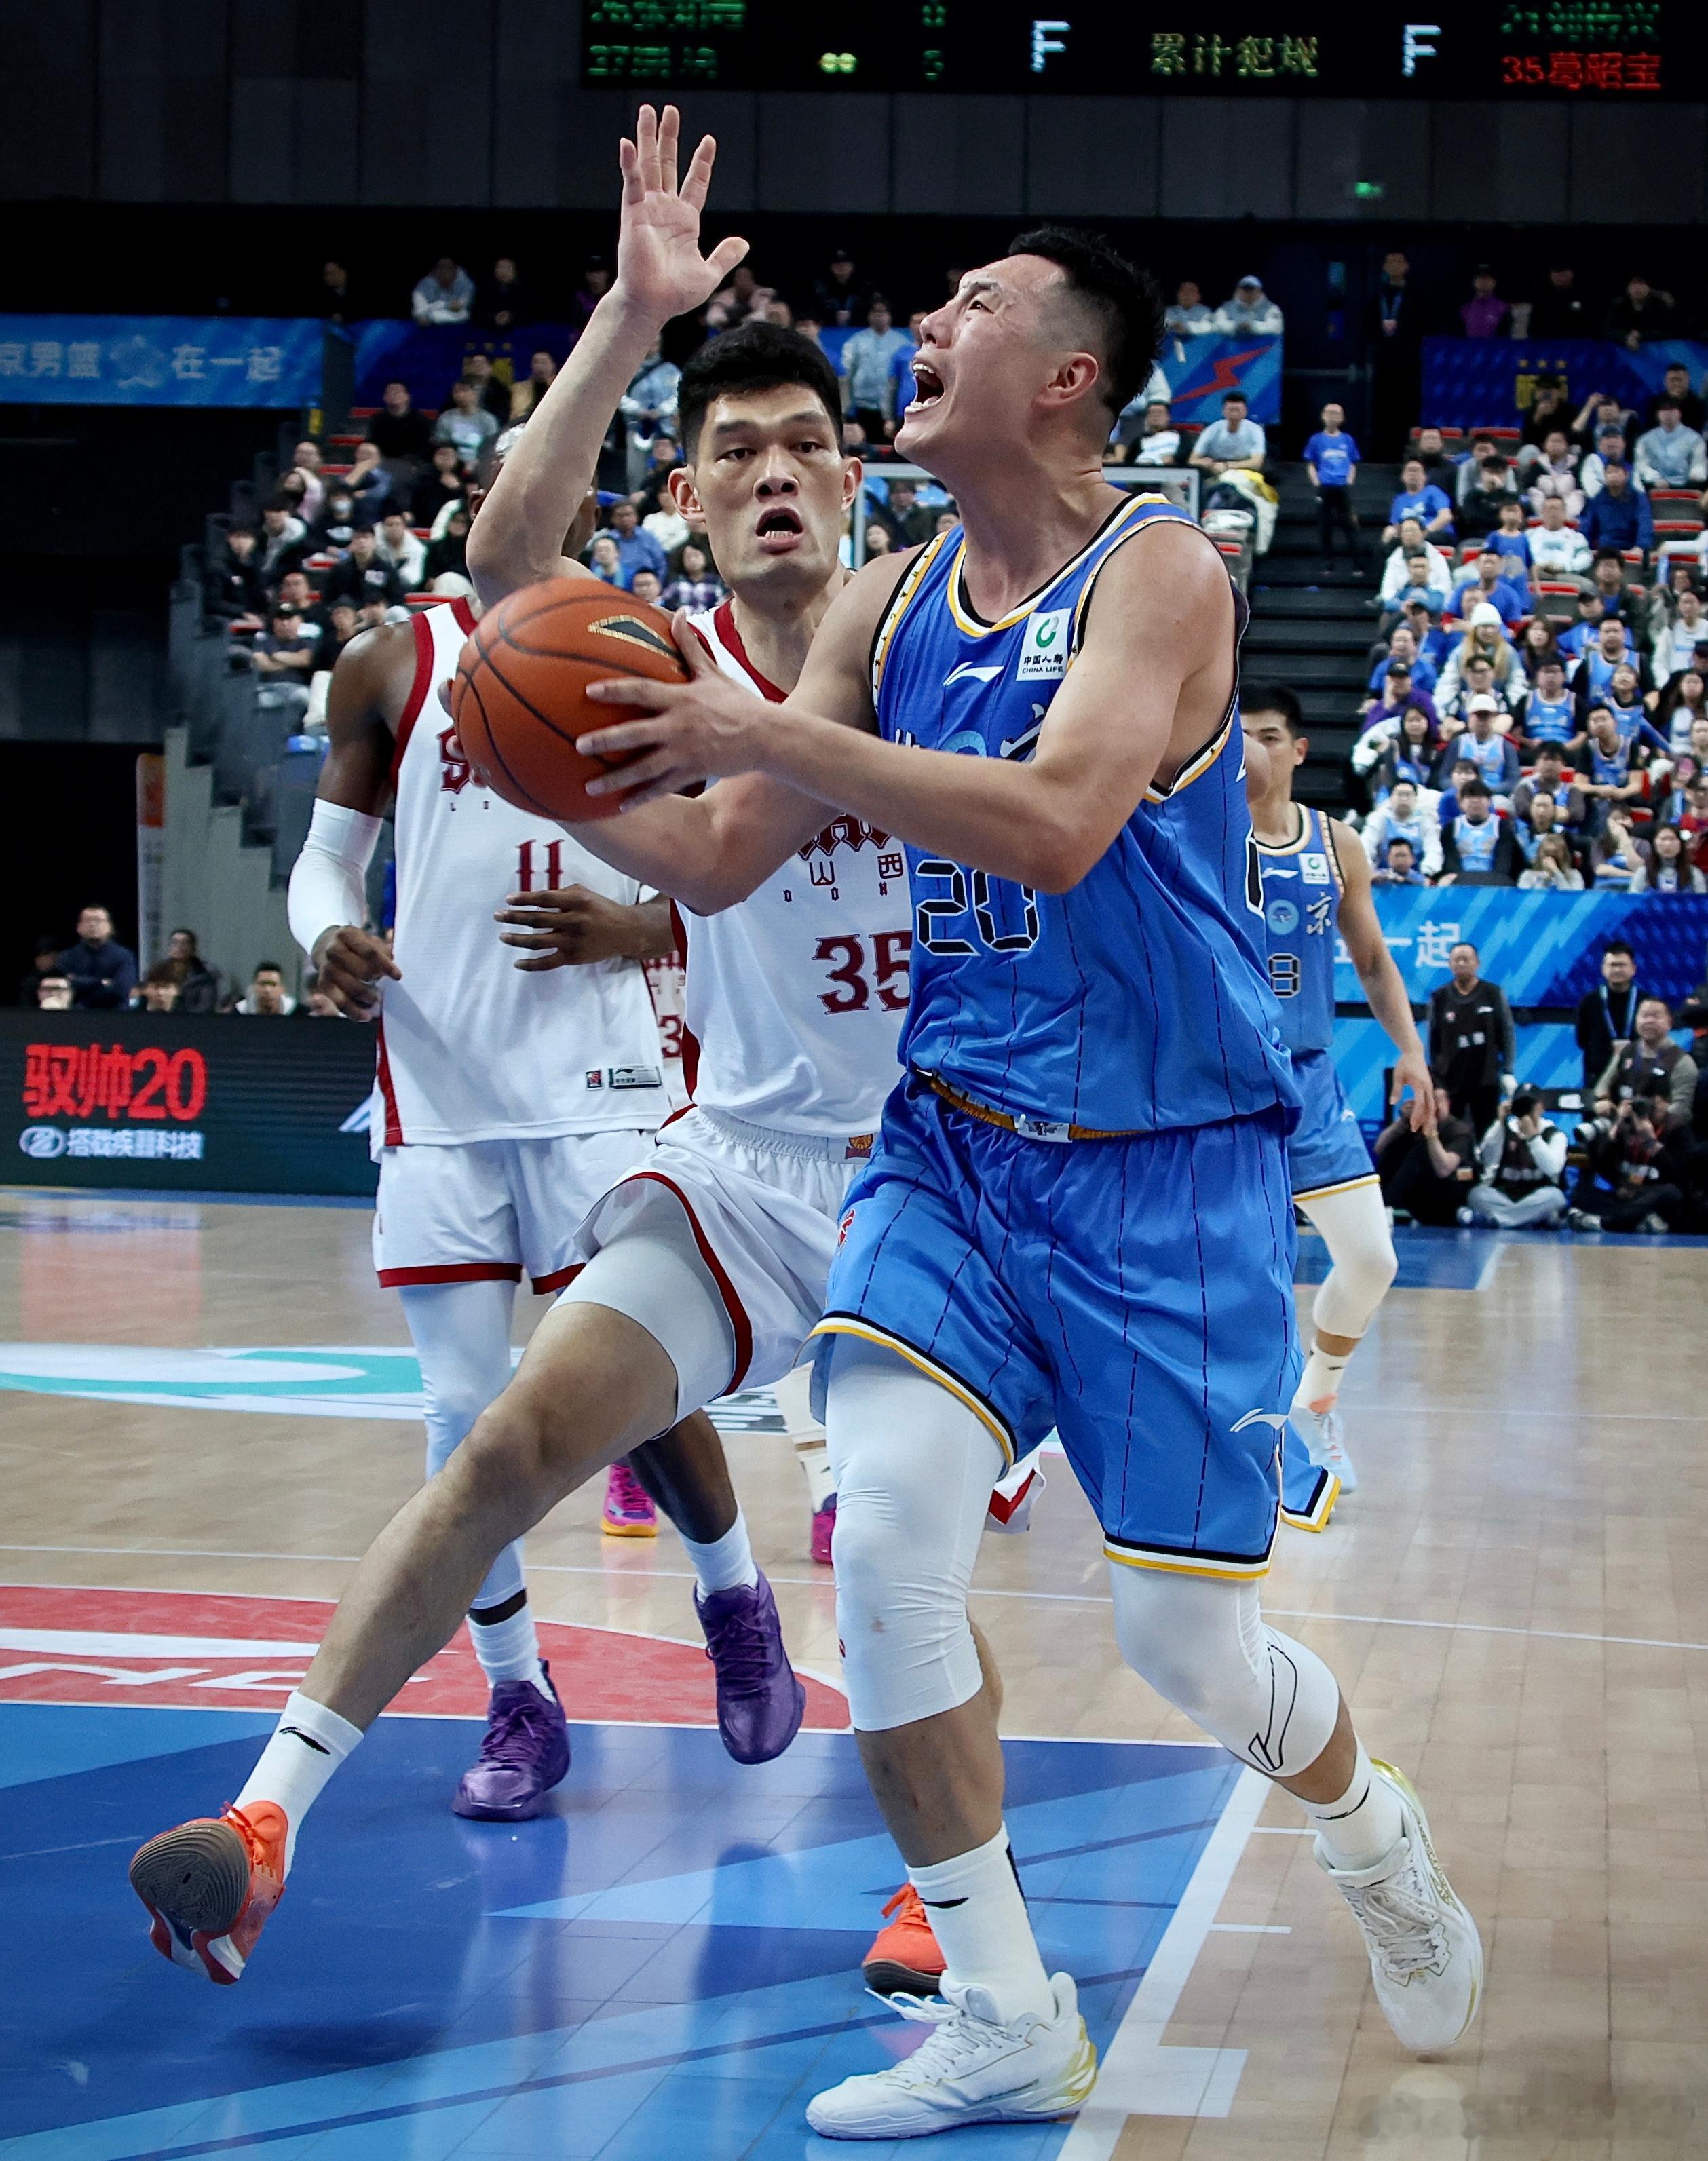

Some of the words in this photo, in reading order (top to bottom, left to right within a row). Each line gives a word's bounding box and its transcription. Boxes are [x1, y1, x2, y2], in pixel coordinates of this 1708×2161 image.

[1031, 20, 1071, 73] F
[1401, 24, 1441, 76] F
[1023, 653, 1063, 666] 中国人寿
[516, 839, 565, 892] 11
[916, 859, 1040, 957] 20
[812, 930, 913, 1015] 35
[22, 1044, 208, 1120] 驭帅20
